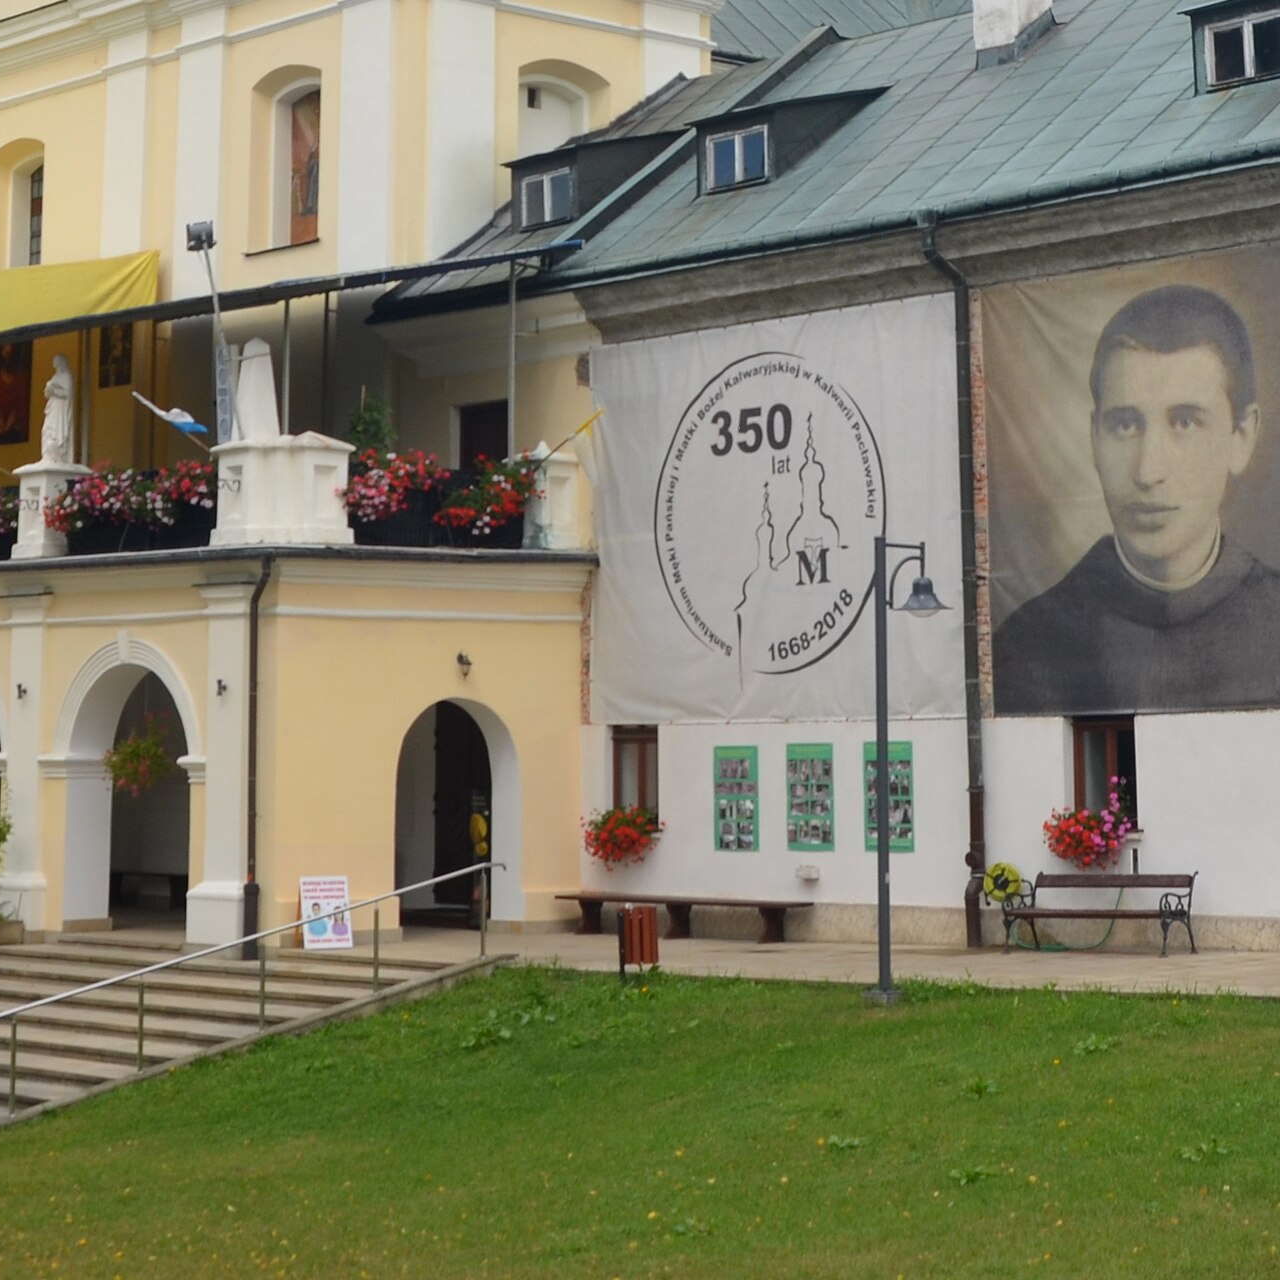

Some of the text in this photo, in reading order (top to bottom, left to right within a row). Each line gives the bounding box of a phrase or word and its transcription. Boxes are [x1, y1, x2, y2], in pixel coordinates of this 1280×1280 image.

[723, 360, 801, 391] Kalwaryjskiej
[802, 369, 813, 380] w
[814, 373, 854, 422] Kalwarii
[696, 387, 724, 421] Bożej
[675, 421, 699, 463] Matki
[710, 403, 793, 457] 350
[771, 455, 791, 475] lat
[851, 421, 877, 519] Pacławskiej
[664, 476, 679, 542] Pańskiej
[679, 586, 733, 657] Sanktuarium
[767, 588, 854, 662] 1668-2018
